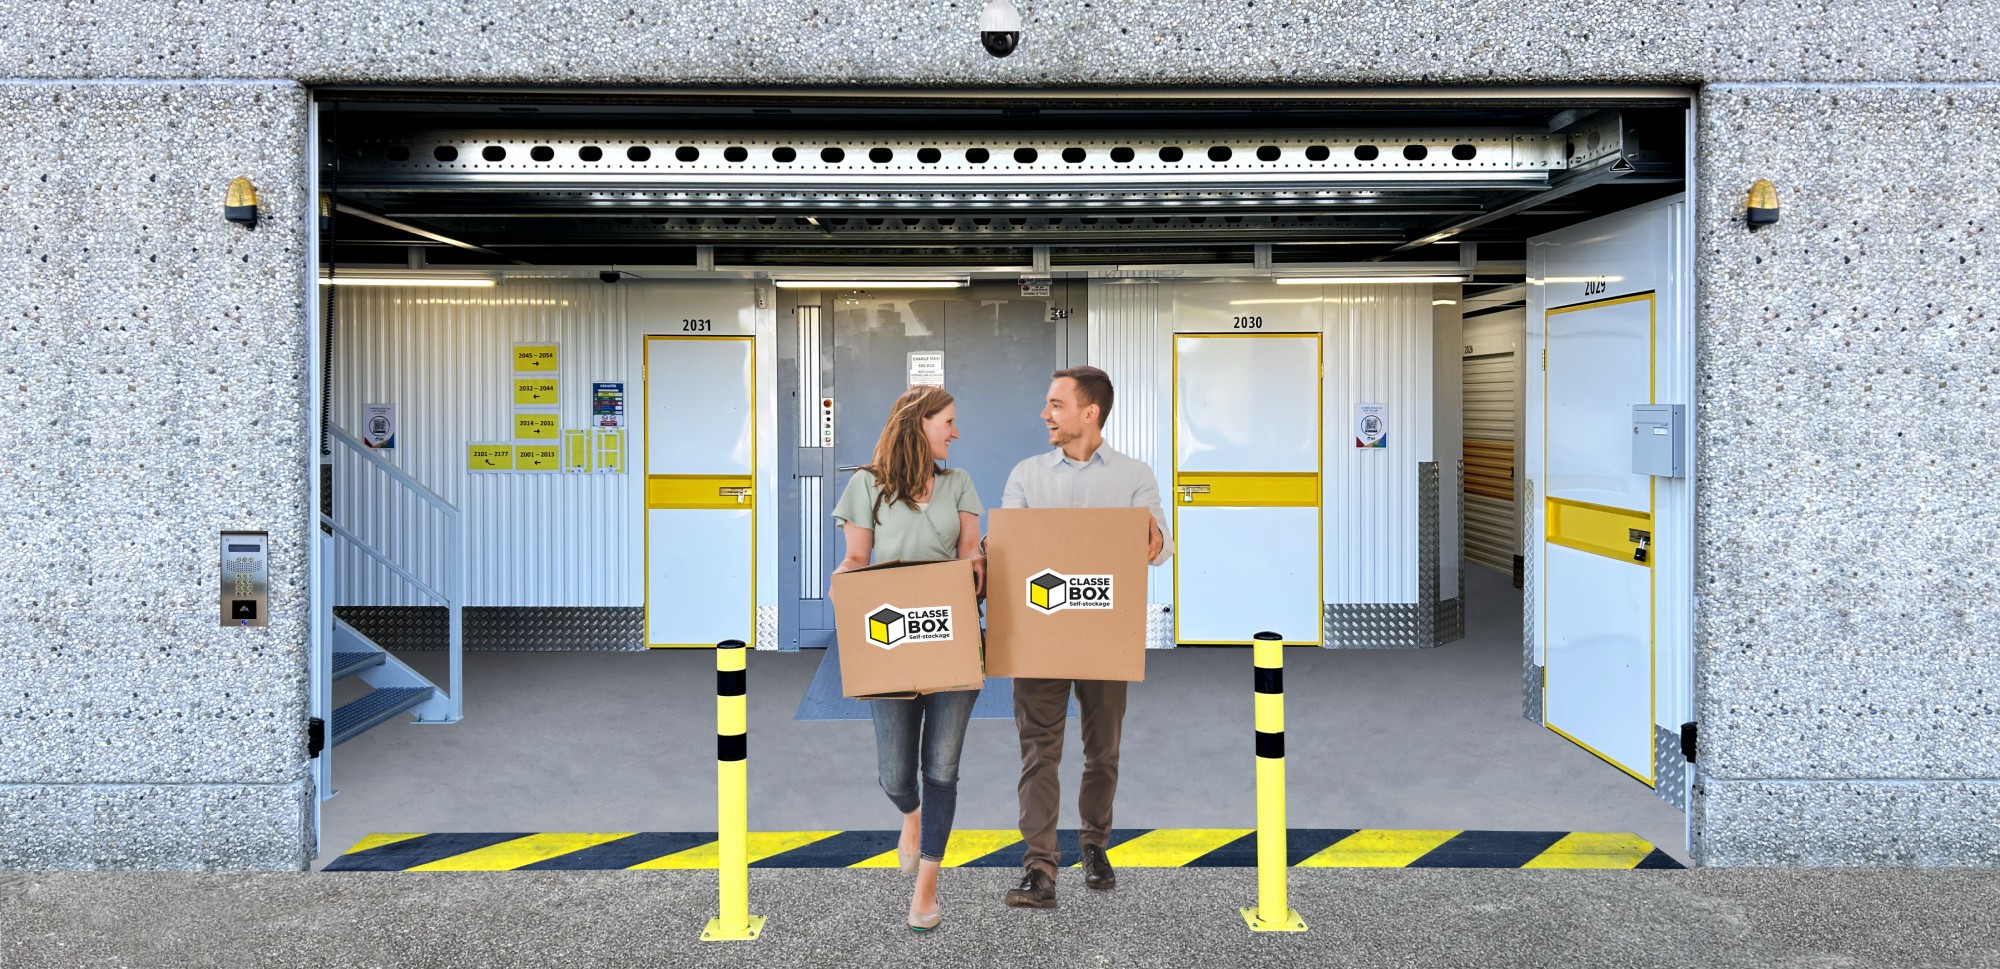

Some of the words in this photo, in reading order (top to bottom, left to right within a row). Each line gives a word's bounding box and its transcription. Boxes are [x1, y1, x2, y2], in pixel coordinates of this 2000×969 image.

[1585, 275, 1606, 296] 2029
[682, 319, 711, 331] 2031
[1233, 316, 1262, 329] 2030
[1069, 578, 1110, 586] CLASSE
[1069, 586, 1110, 601] BOX
[907, 609, 949, 619] CLASSE
[908, 618, 950, 634] BOX
